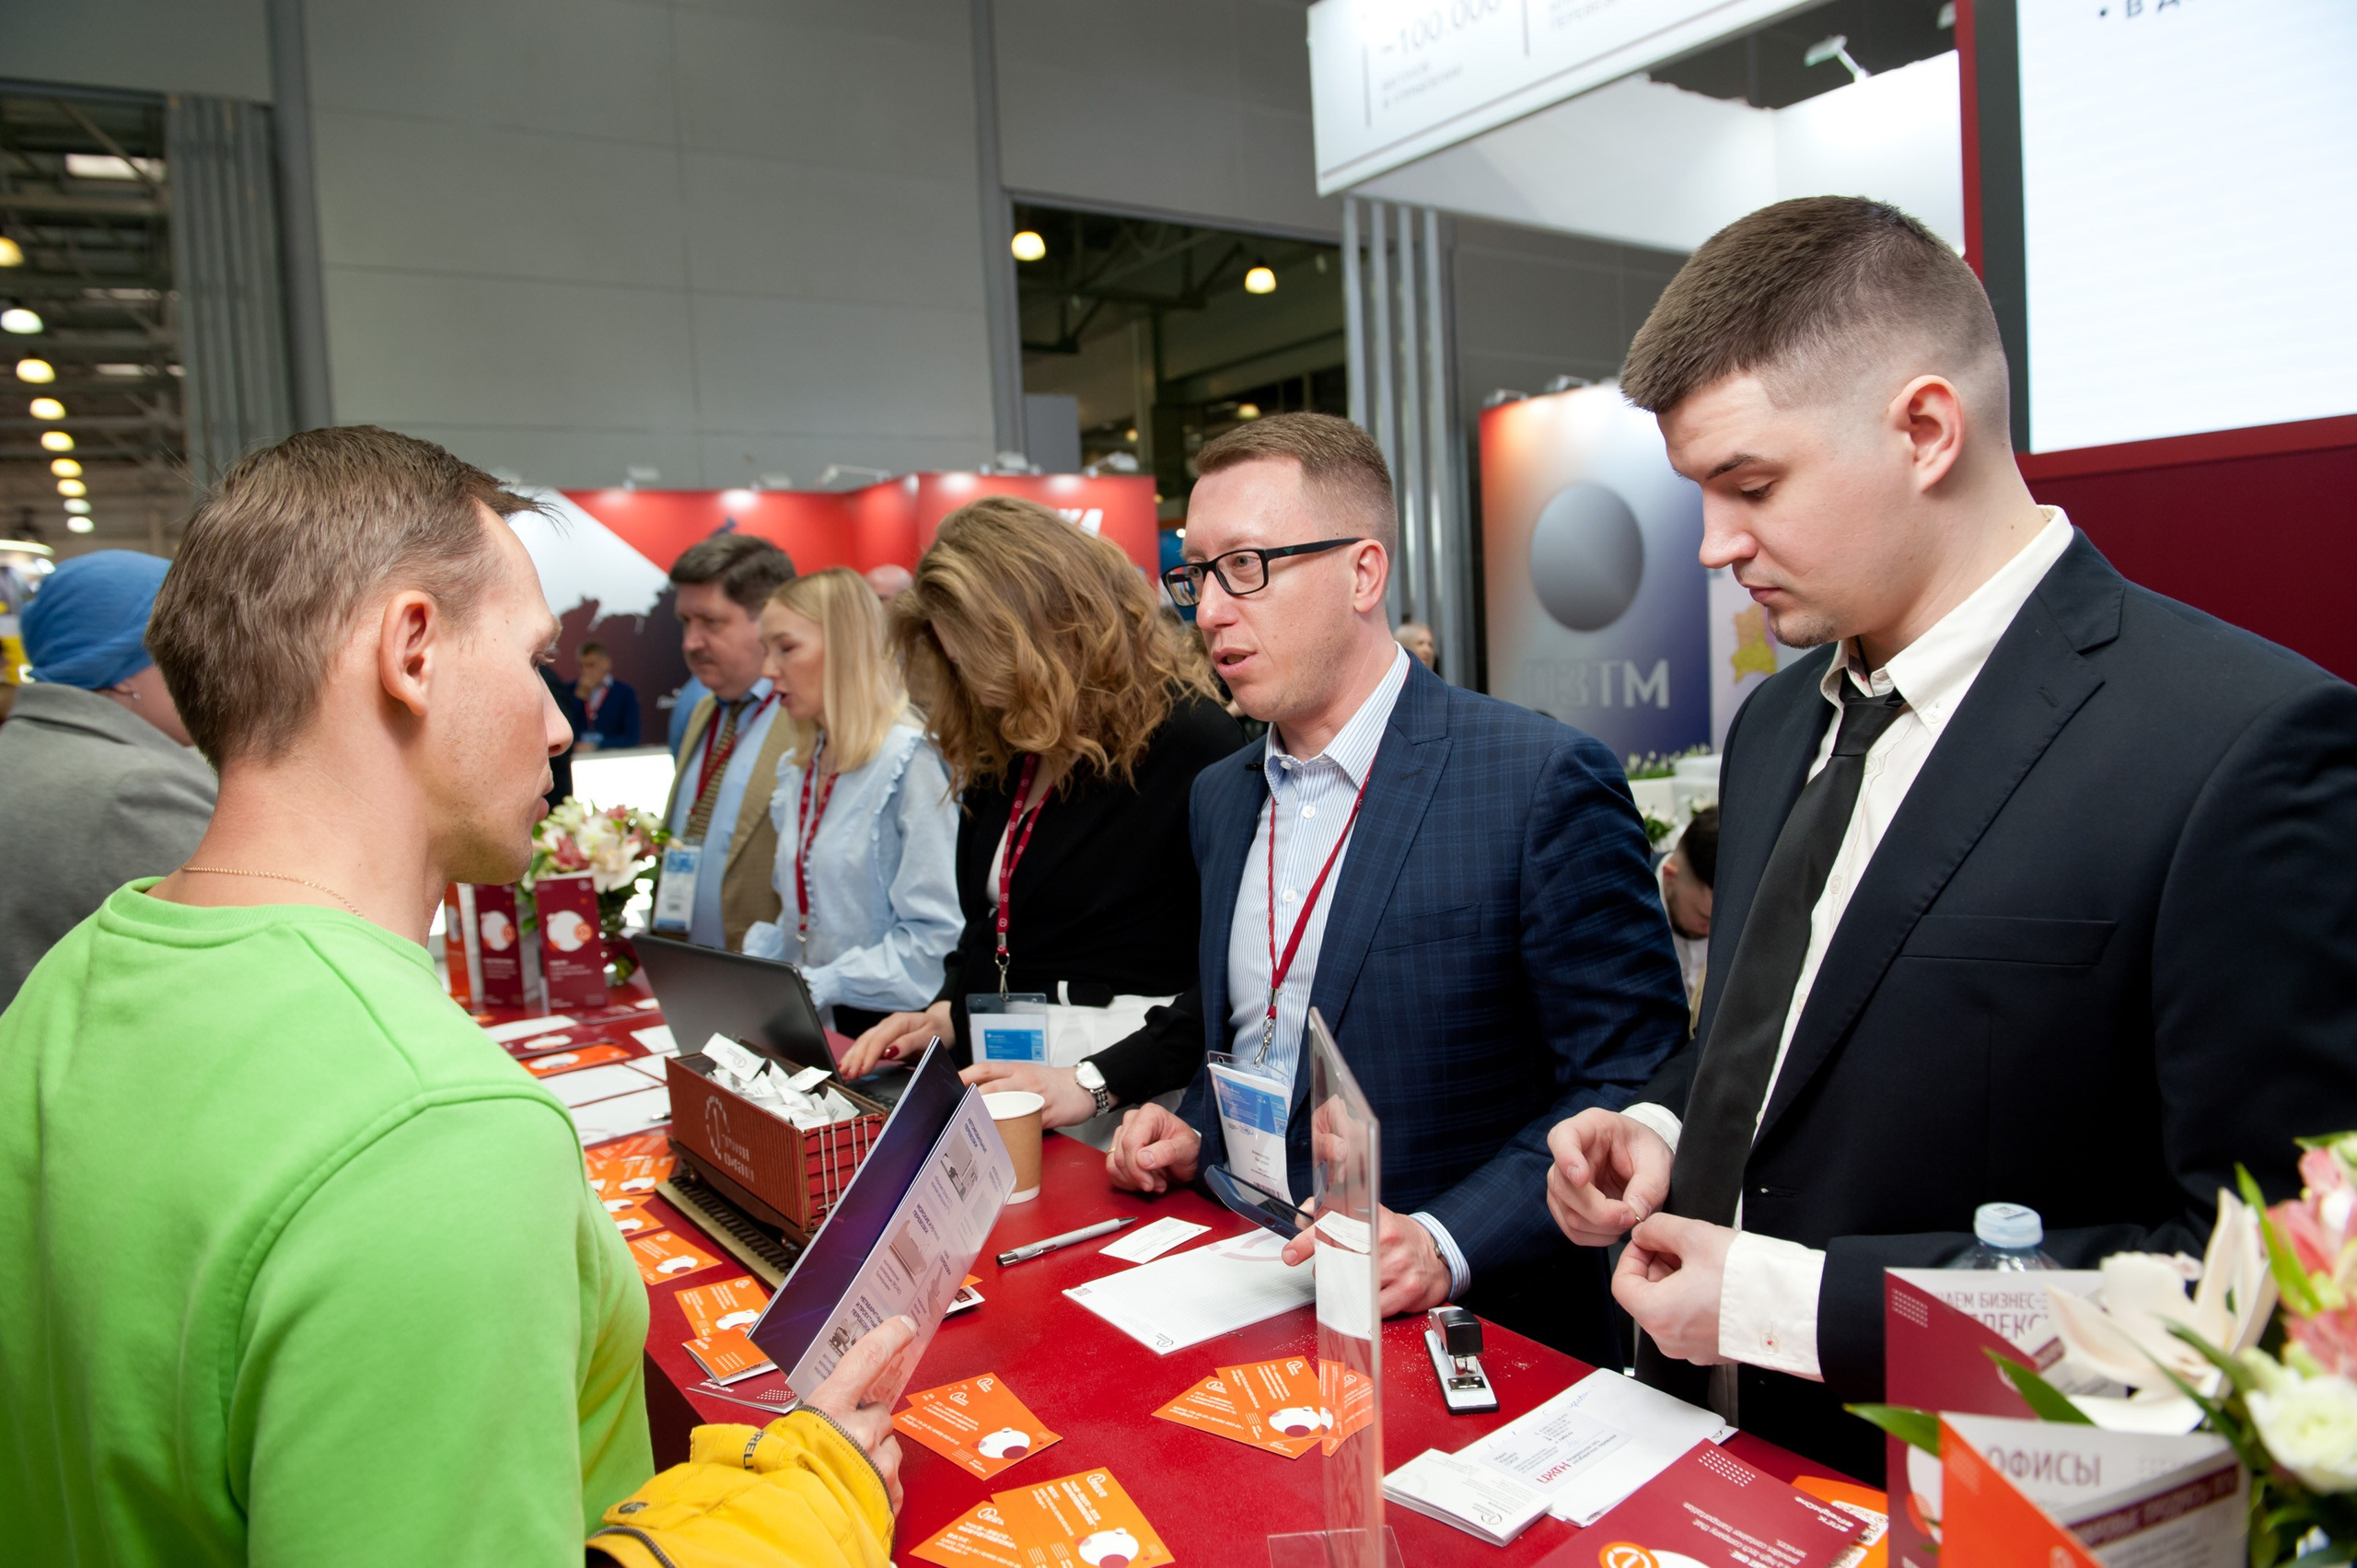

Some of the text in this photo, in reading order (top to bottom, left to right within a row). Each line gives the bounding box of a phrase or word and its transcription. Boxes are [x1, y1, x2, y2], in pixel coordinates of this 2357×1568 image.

[1682, 1501, 1734, 1534] transportation
[1692, 1518, 1711, 1532] that
[1710, 1526, 1744, 1549] company
[1734, 1527, 1768, 1551] container
[1775, 1539, 1808, 1559] services.
[1742, 1542, 1778, 1565] high-tech
[1766, 1544, 1801, 1566] provides
